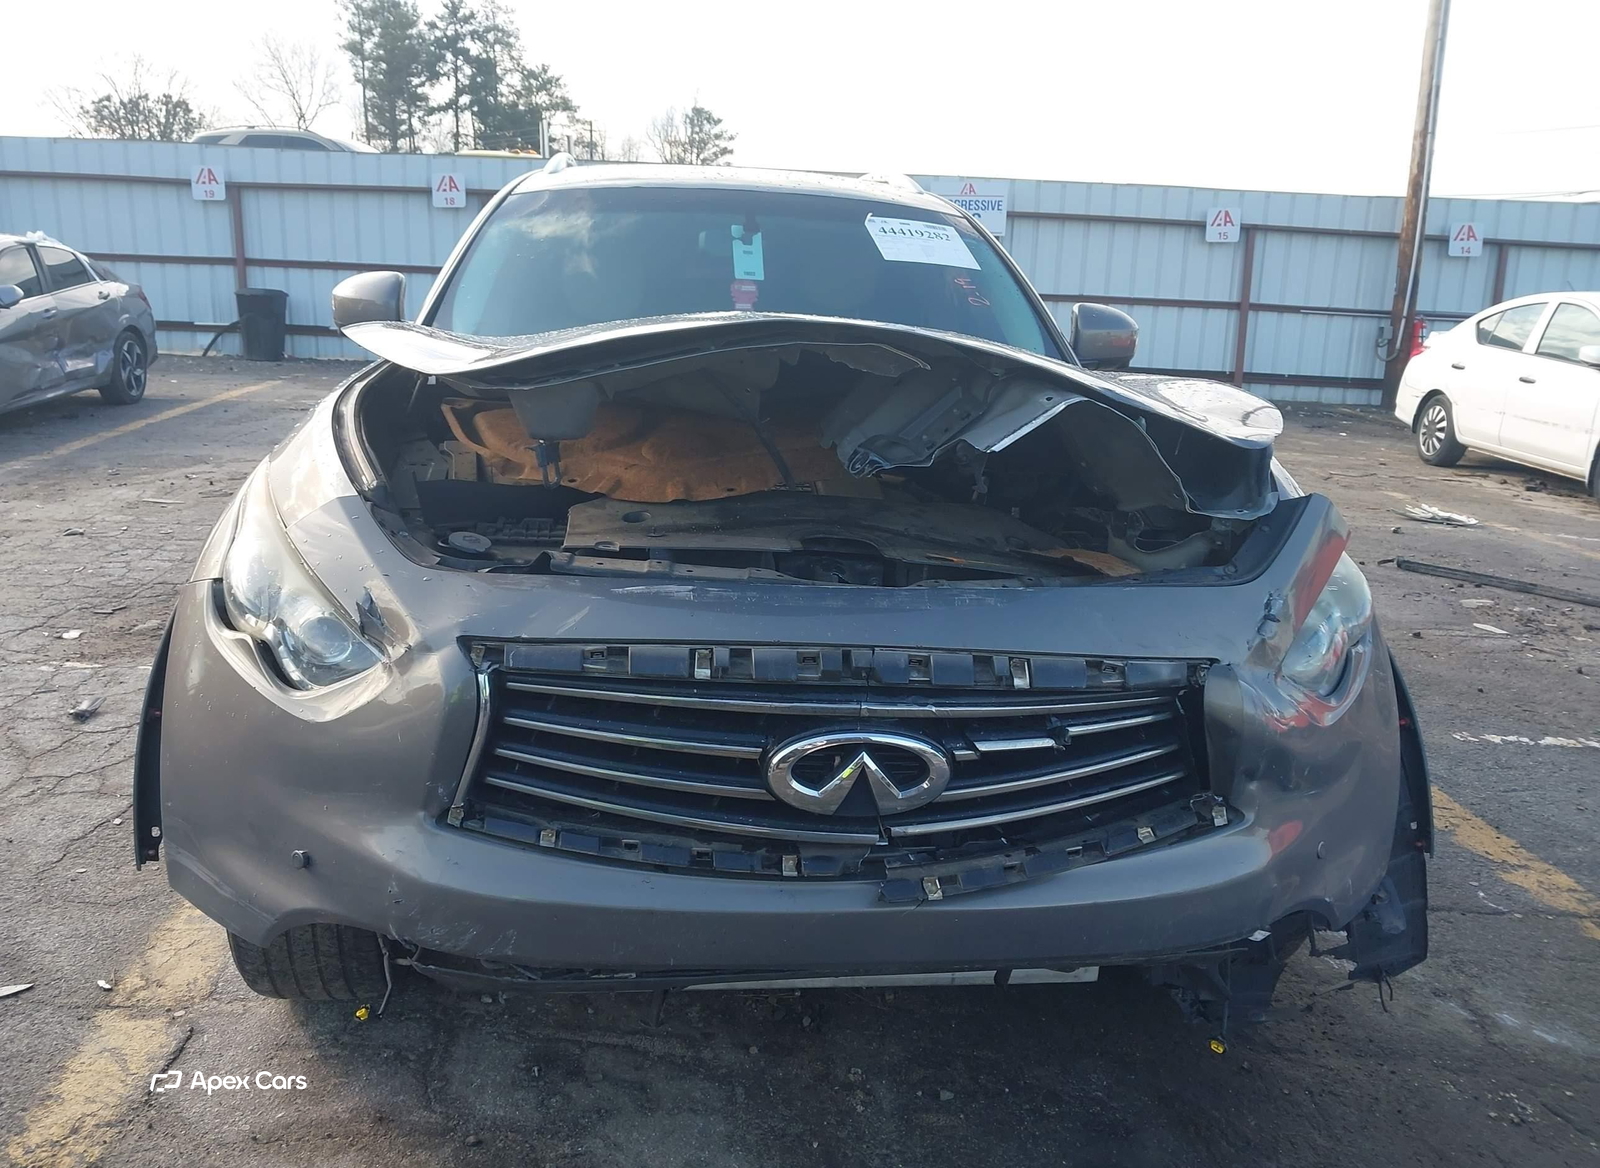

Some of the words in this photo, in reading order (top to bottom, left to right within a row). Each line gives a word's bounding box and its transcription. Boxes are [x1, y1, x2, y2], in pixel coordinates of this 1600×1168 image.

[204, 190, 215, 199] 19
[444, 197, 456, 206] 18
[948, 199, 1003, 211] GRESSIVE
[879, 226, 951, 242] 44419282
[1217, 231, 1229, 240] 15
[1461, 246, 1471, 255] 14
